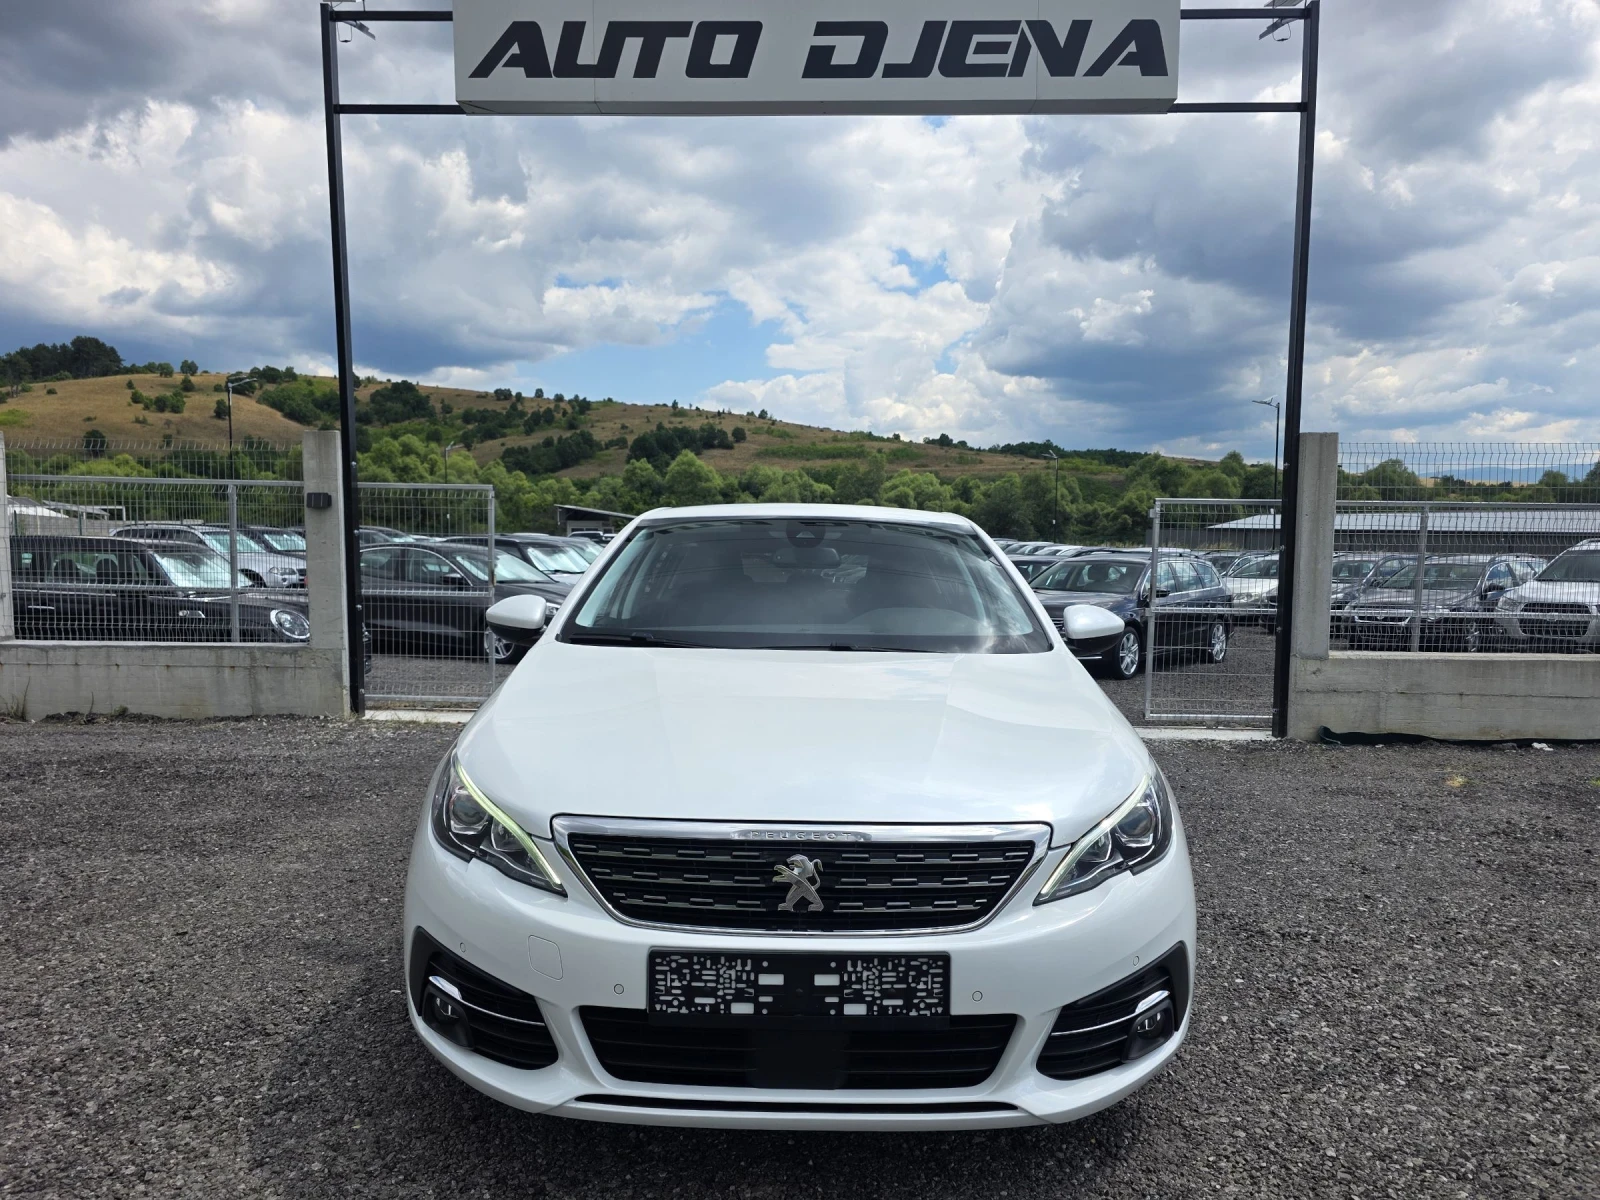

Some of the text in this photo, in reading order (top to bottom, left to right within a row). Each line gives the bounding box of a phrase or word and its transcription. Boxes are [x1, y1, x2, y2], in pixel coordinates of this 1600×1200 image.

[468, 18, 1169, 79] AUTO DJENA
[750, 830, 852, 841] PEUGEOT
